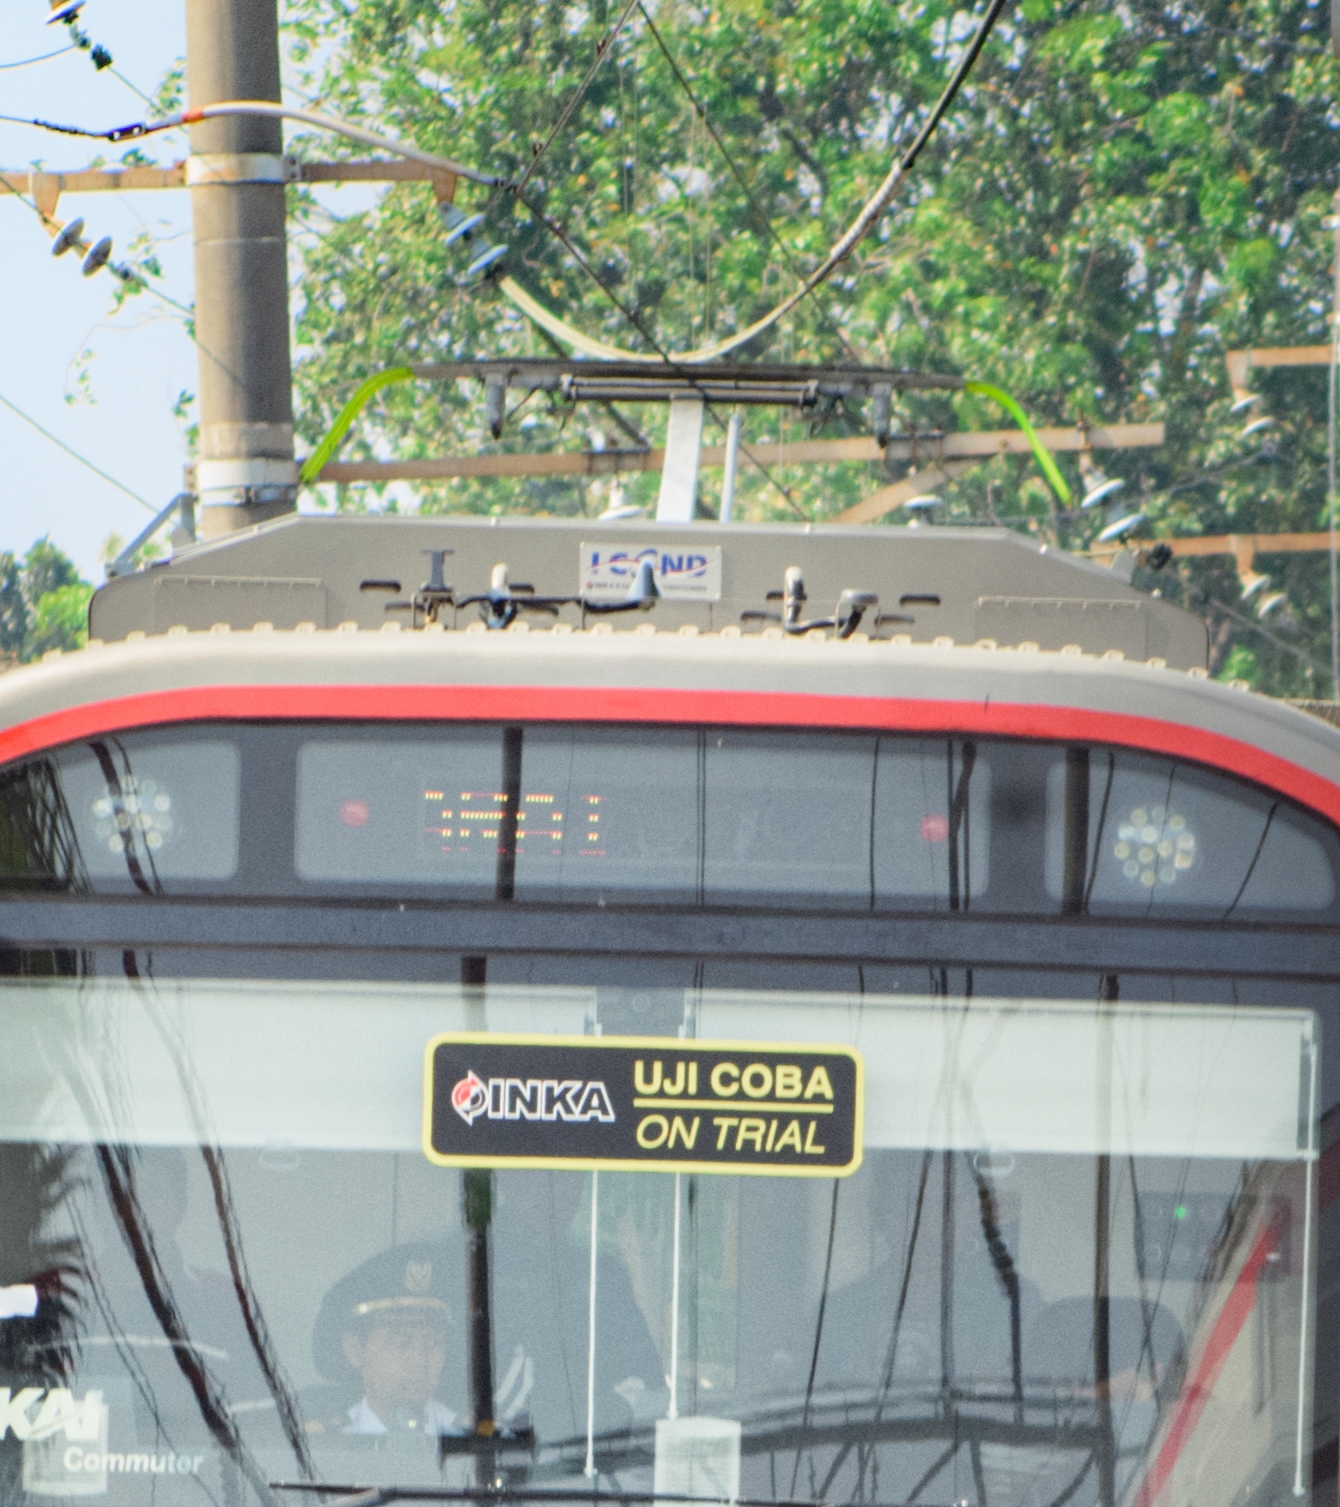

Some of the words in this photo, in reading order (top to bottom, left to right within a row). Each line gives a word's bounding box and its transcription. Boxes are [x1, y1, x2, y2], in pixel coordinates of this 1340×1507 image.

[634, 1060, 698, 1096] UJI
[711, 1062, 834, 1099] COBA
[488, 1078, 616, 1122] INKA
[636, 1114, 701, 1150] ON
[713, 1116, 826, 1154] TRIAL
[63, 1446, 204, 1473] Commuter
